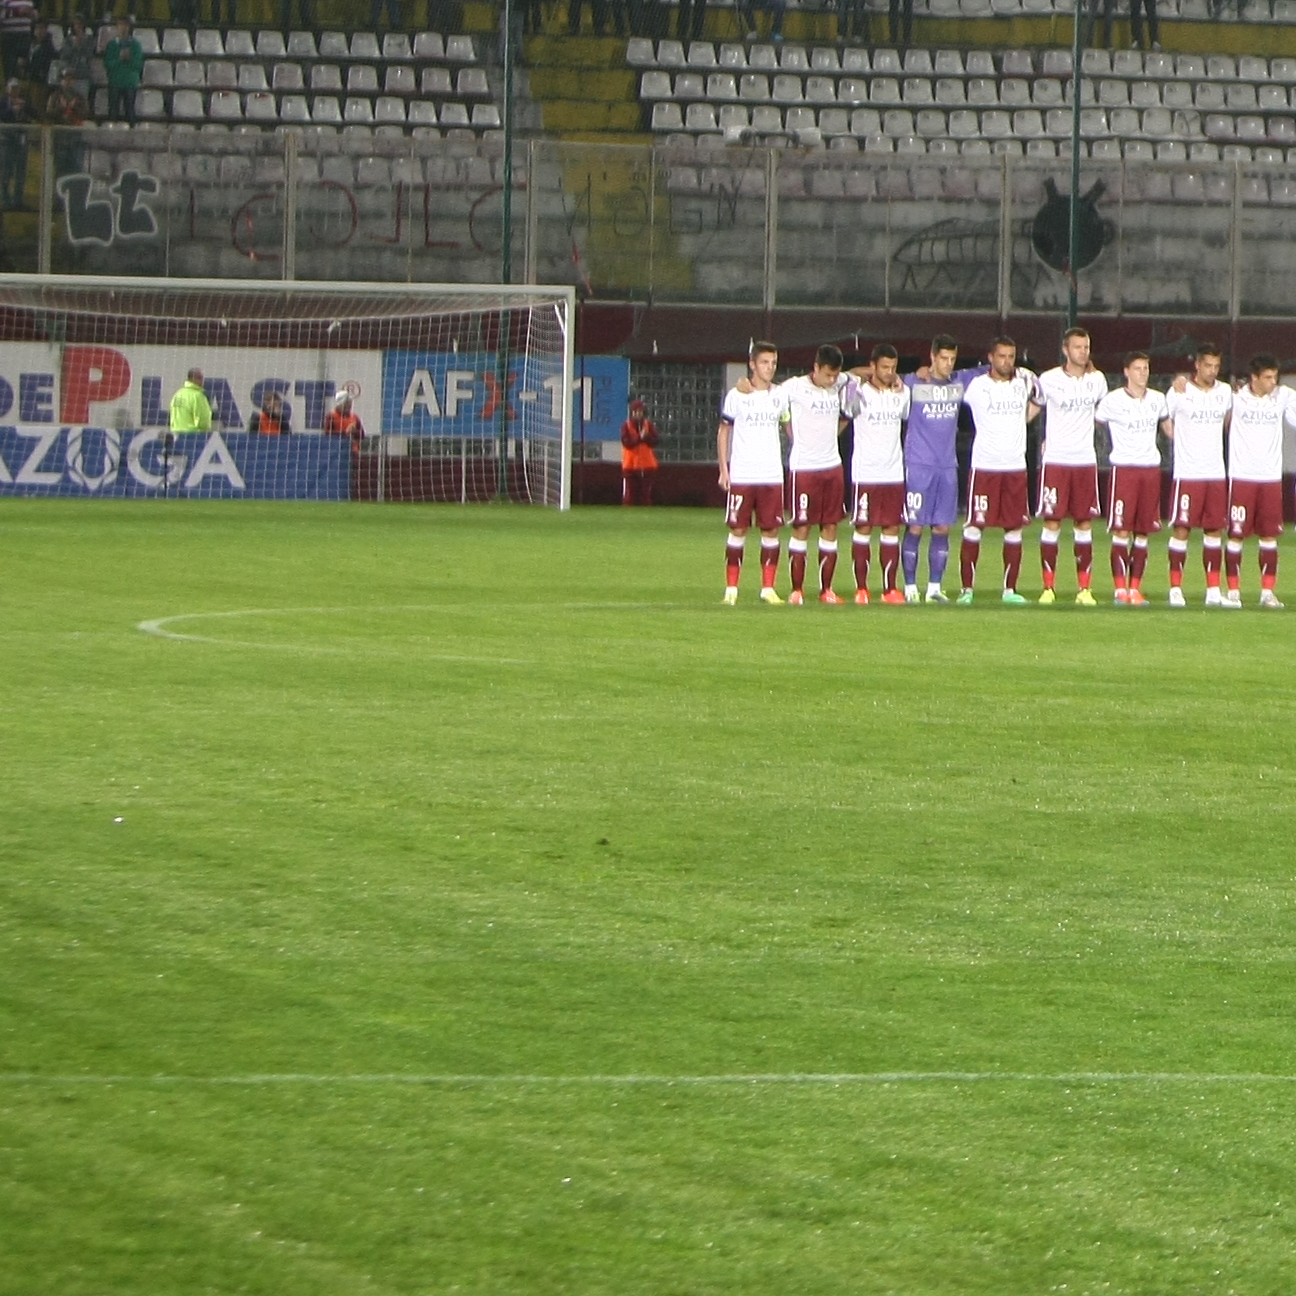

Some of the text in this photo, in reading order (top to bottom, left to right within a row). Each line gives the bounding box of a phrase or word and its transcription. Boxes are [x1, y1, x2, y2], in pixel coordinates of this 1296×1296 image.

[0, 346, 336, 429] EPLAST
[401, 368, 593, 422] AFX-11
[811, 400, 840, 410] AZUG
[1241, 410, 1278, 420] AZUGA
[0, 426, 247, 490] ZUGA
[730, 494, 744, 511] 17
[859, 492, 868, 511] 4
[1044, 487, 1057, 505] 24
[1181, 494, 1190, 510] 6
[1115, 500, 1124, 516] 8
[1231, 505, 1246, 522] 80
